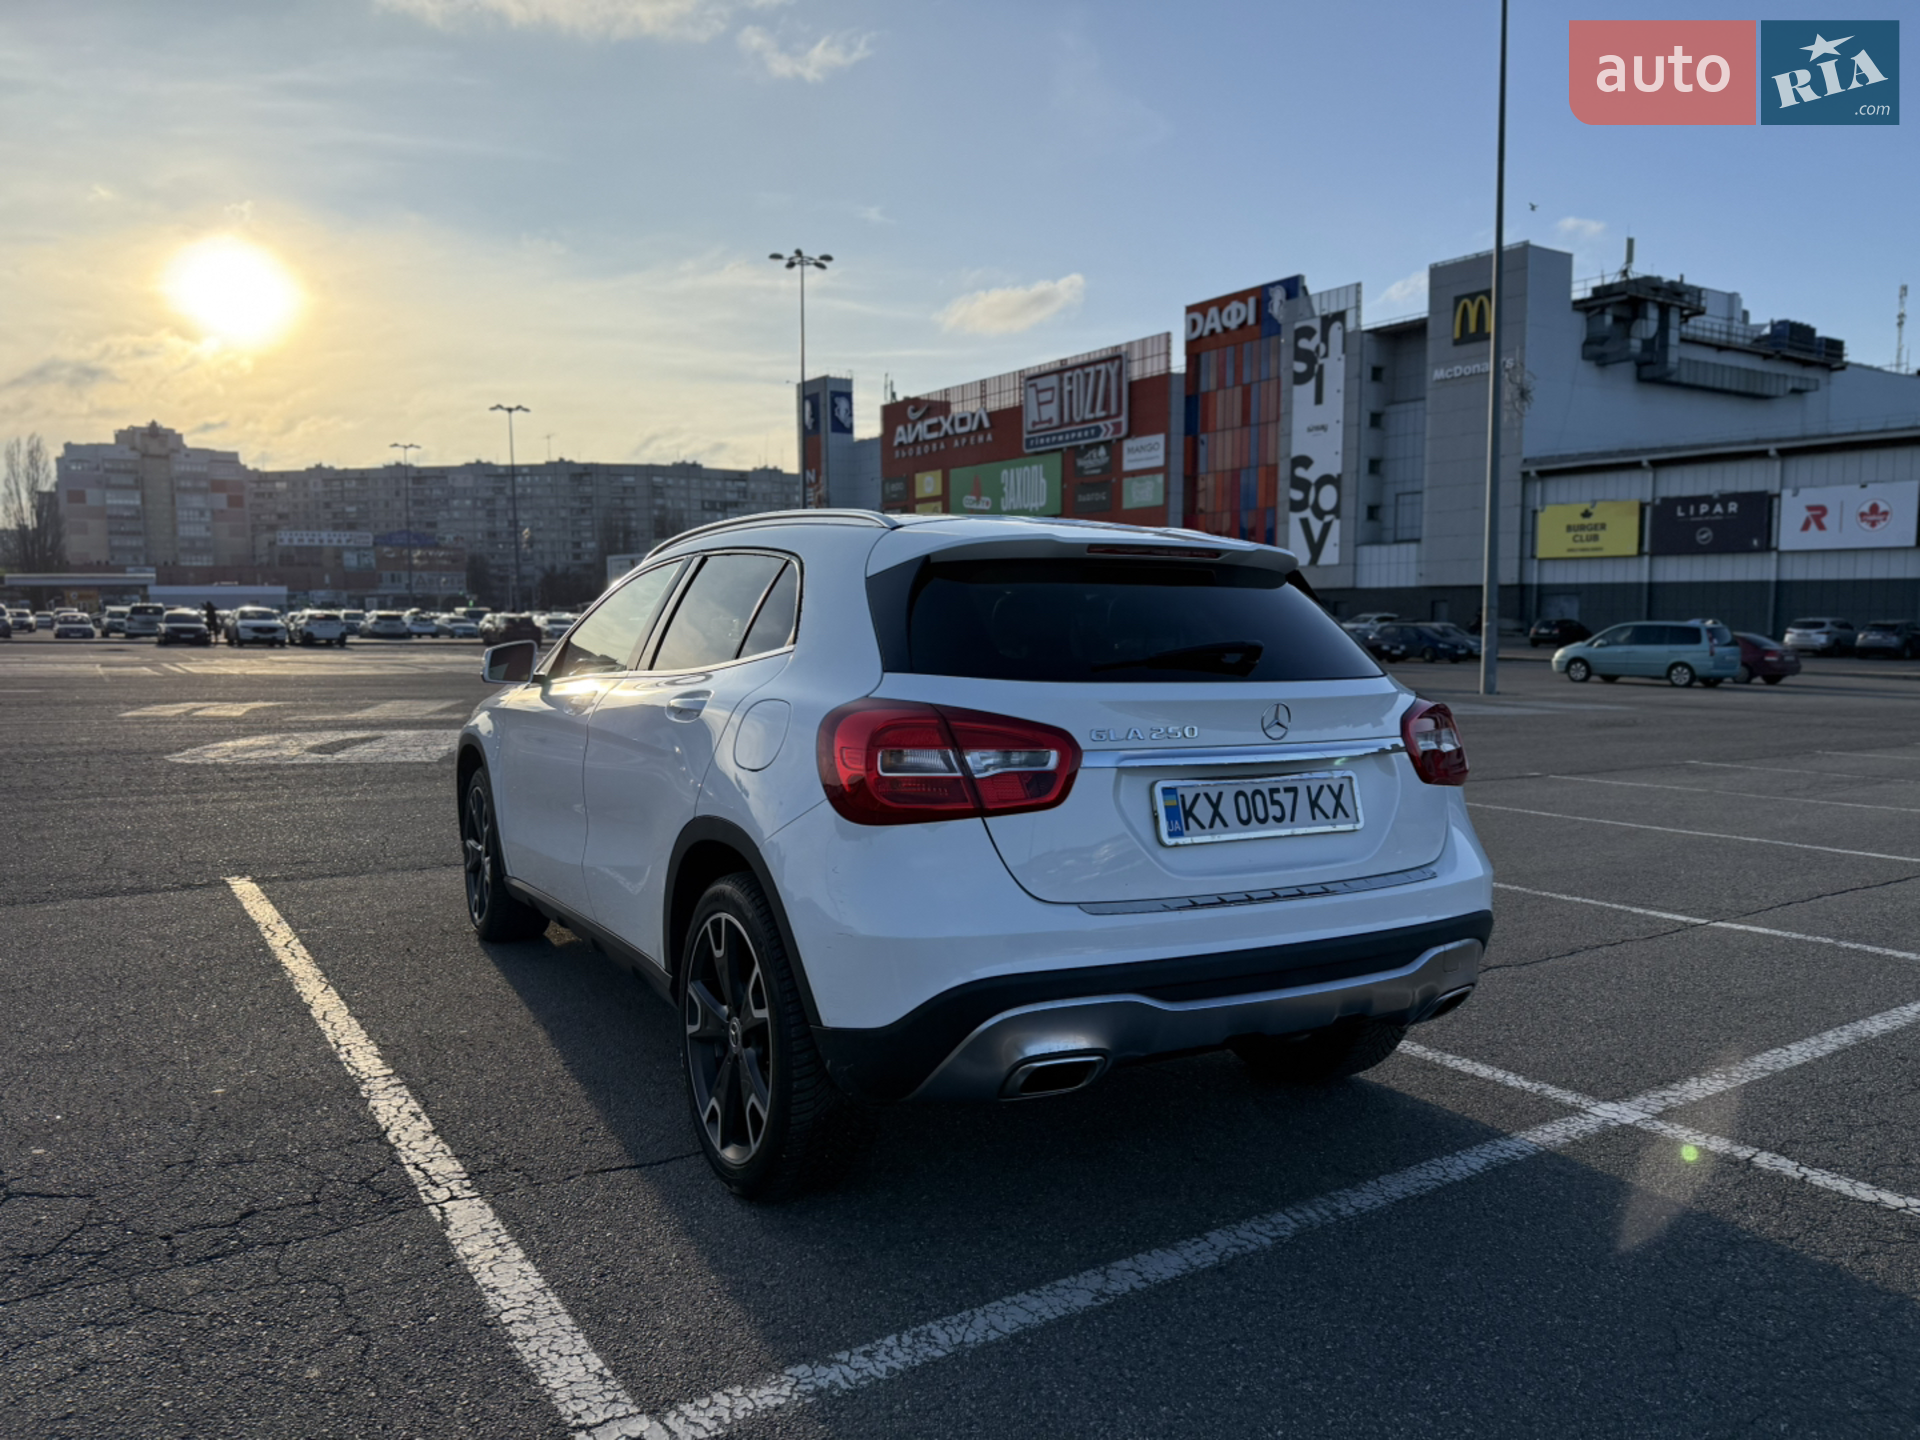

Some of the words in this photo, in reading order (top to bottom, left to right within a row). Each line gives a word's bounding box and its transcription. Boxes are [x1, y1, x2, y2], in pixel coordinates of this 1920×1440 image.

[1433, 357, 1514, 381] McDona's
[1063, 359, 1120, 424] FOZZY
[1127, 442, 1160, 455] MANGO
[1001, 464, 1047, 512] ЗАХОДЬ
[1676, 501, 1738, 517] LIPAR
[1566, 522, 1607, 533] BURGER
[1572, 534, 1600, 543] CLUB
[1090, 727, 1145, 742] GLA
[1150, 725, 1199, 741] 250
[1234, 786, 1299, 826] 0057
